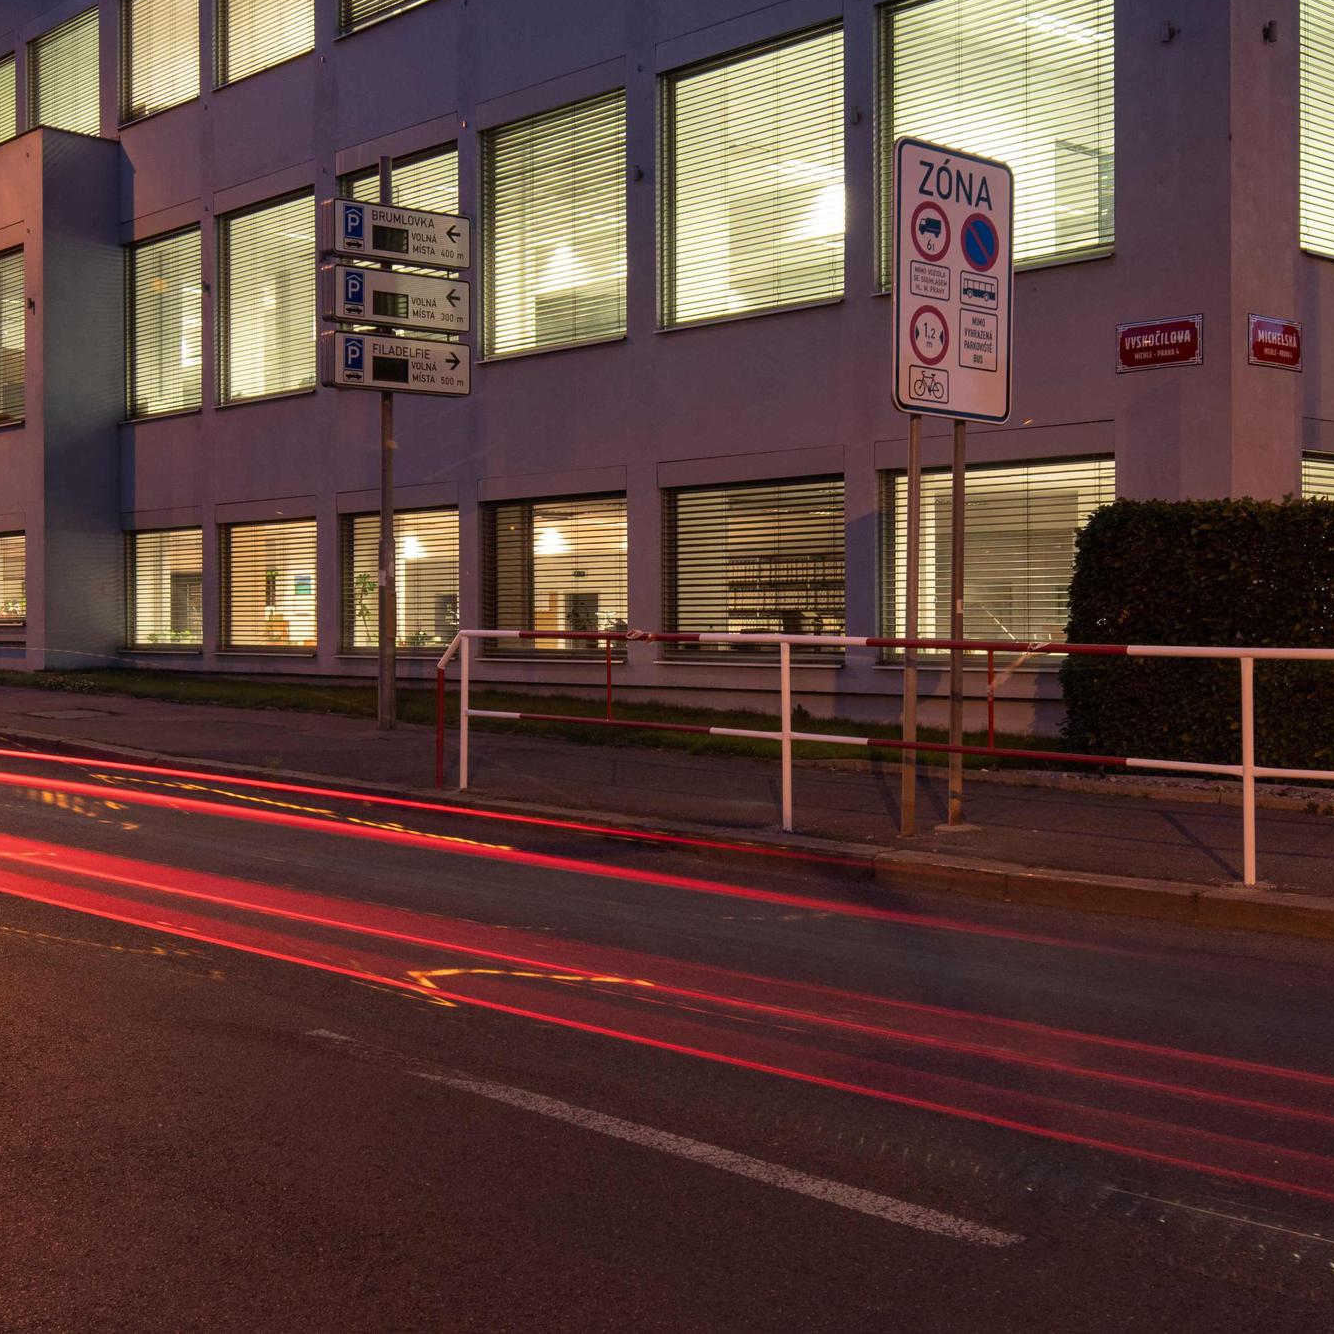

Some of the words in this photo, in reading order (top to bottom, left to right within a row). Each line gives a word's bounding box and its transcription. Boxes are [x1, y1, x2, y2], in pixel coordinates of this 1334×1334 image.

[918, 158, 993, 211] ZÓNA
[347, 213, 360, 233] P
[371, 209, 435, 229] BRUMLOVKA
[411, 232, 437, 244] VOLNÁ
[412, 244, 436, 256] MÍSTA
[440, 249, 455, 259] 400
[914, 266, 927, 275] MIMO
[928, 268, 946, 278] VOZIDLA
[913, 274, 921, 282] SE
[921, 276, 948, 287] SOUHLASEM
[348, 279, 360, 299] P
[930, 285, 945, 294] PRAHY
[411, 297, 437, 307] VOLNÁ
[412, 309, 436, 320] MÍSTA
[440, 313, 454, 323] 300
[971, 316, 986, 327] MIMO
[964, 328, 993, 340] VYHRAZENÁ
[1125, 330, 1191, 350] VYSKOČILOVA
[1258, 329, 1297, 348] MICHELSKÁ
[926, 341, 933, 349] m
[348, 345, 360, 365] P
[372, 343, 431, 360] FILADELFIE
[1134, 350, 1153, 360] MICHLE
[1157, 348, 1176, 357] PRAHA
[973, 354, 983, 364] BUS
[411, 362, 437, 372] VOLNÁ
[412, 372, 436, 383] MÍSTA
[440, 376, 455, 386] 500
